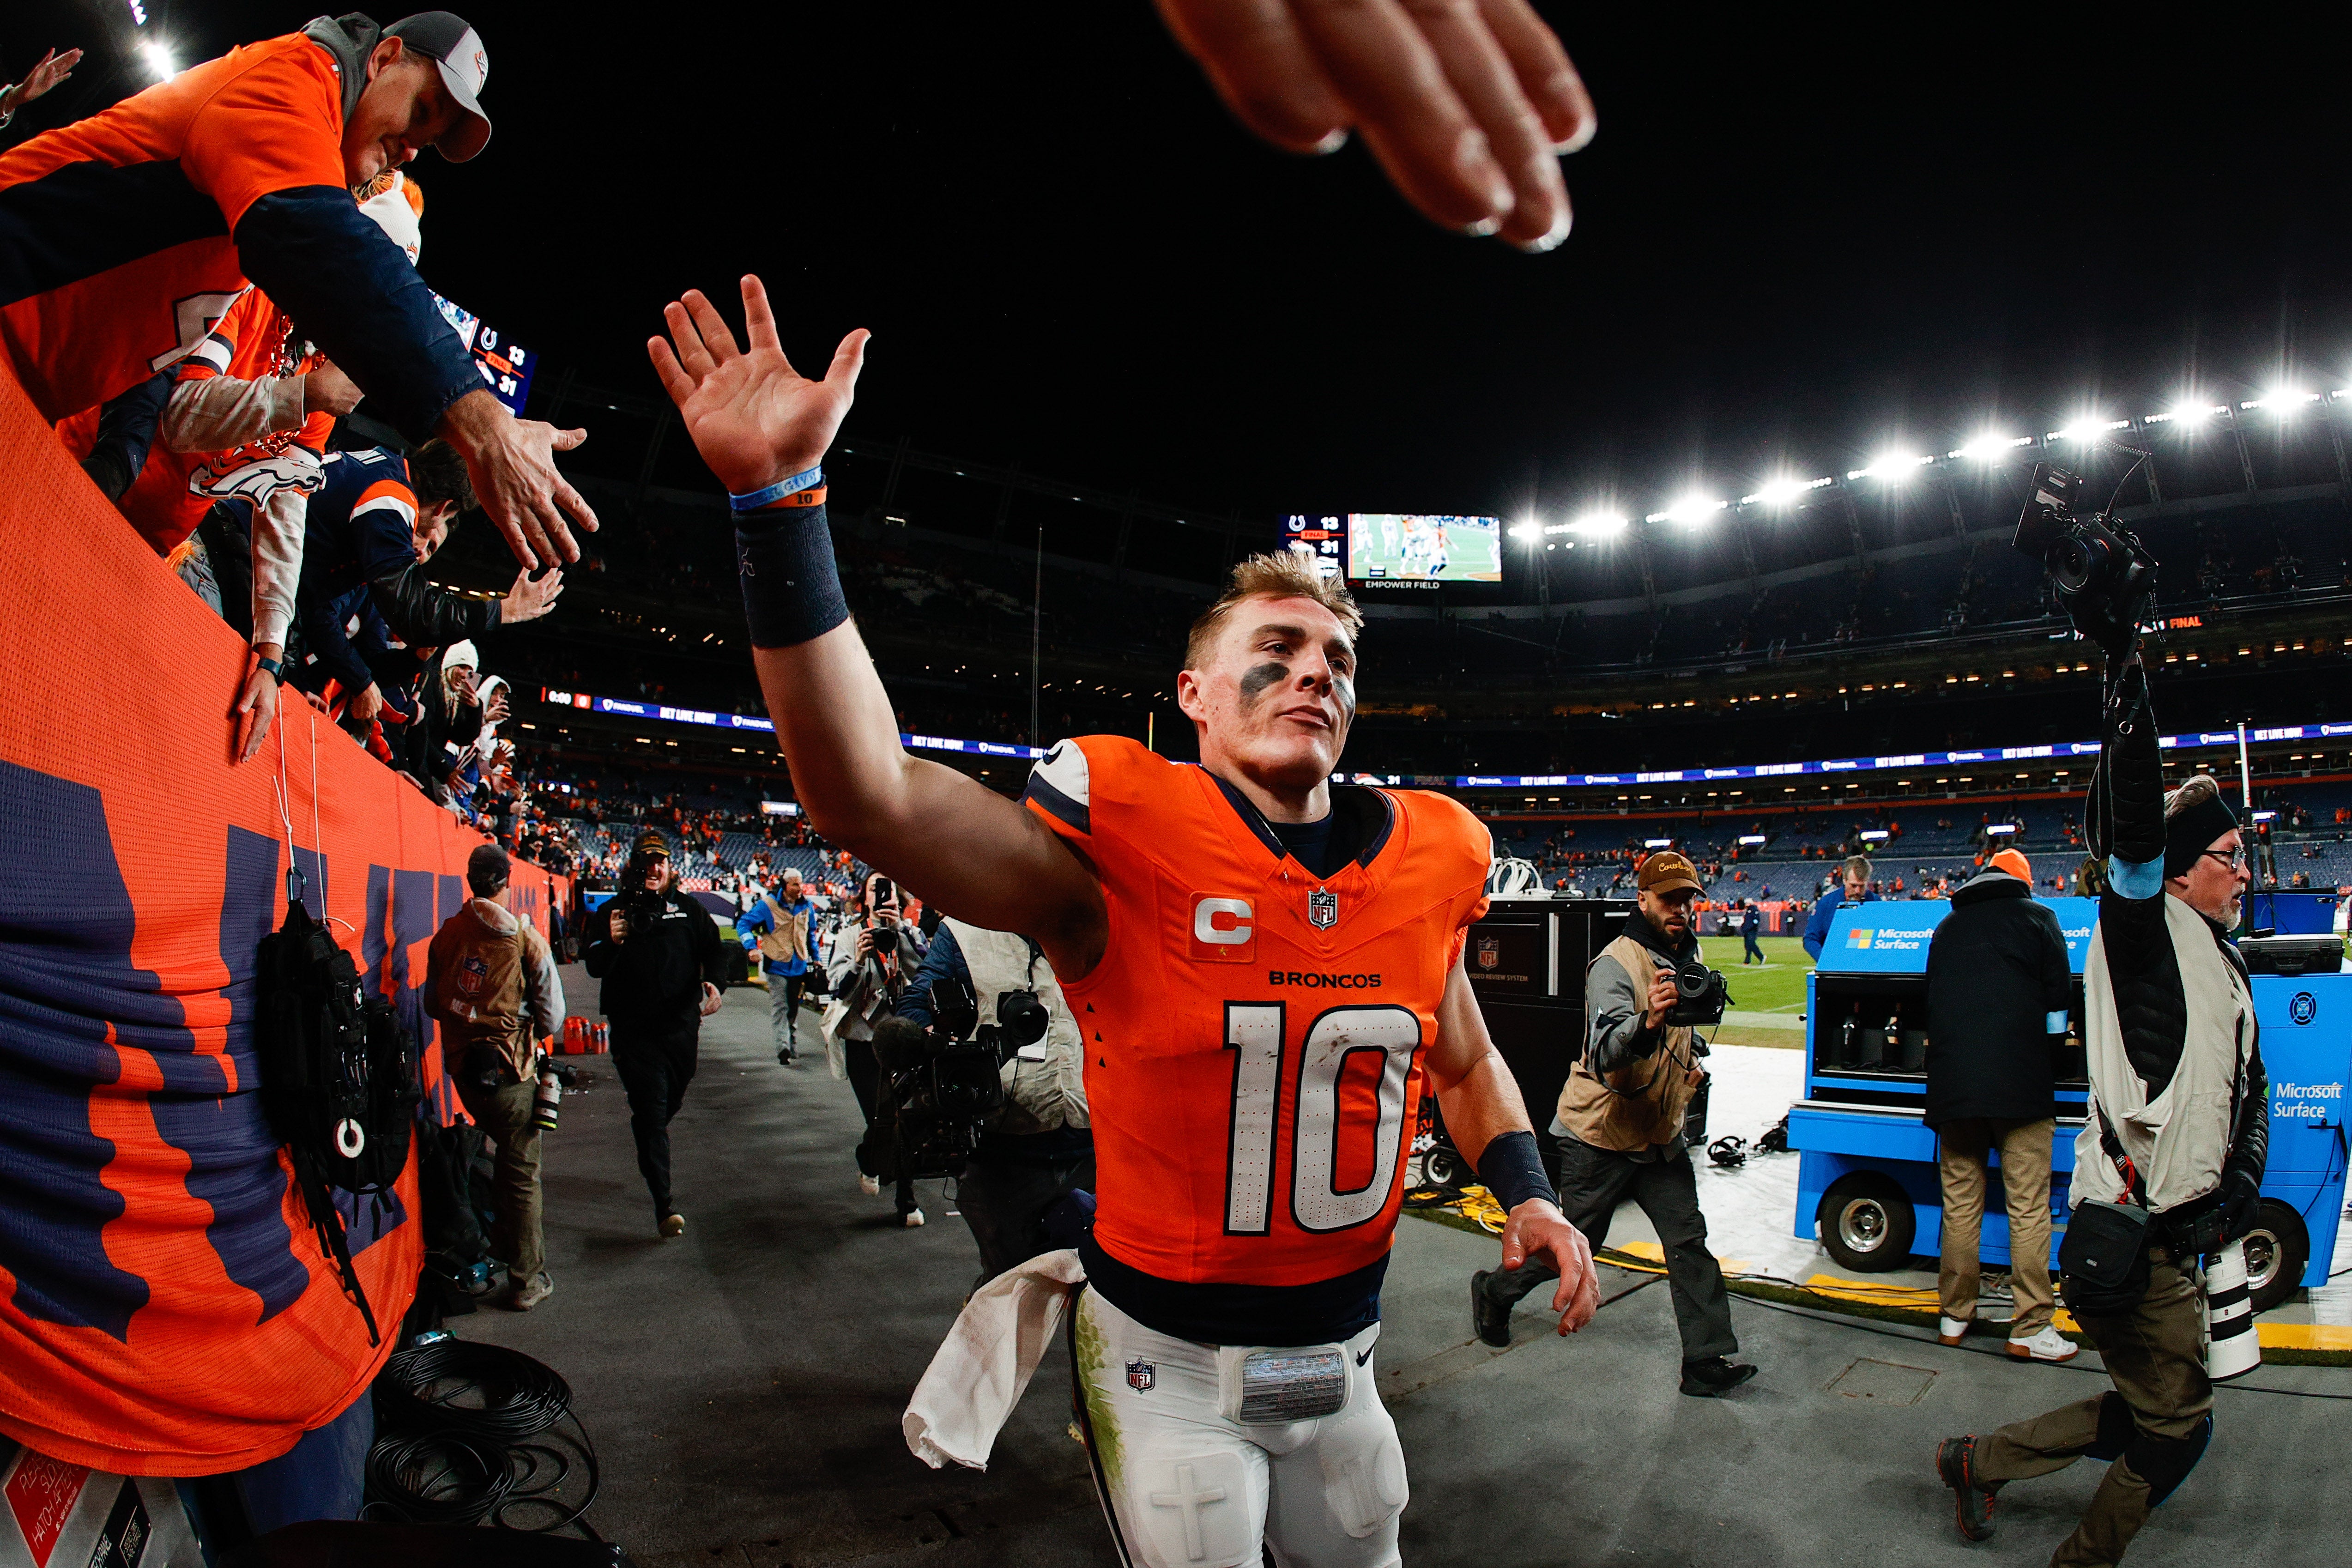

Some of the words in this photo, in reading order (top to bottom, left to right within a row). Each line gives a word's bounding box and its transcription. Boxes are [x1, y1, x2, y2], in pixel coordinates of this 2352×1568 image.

[508, 346, 525, 366] 13
[499, 375, 517, 397] 31
[797, 494, 813, 504] 10
[1320, 516, 1339, 530] 13
[1320, 540, 1339, 554] 31
[1365, 581, 1412, 589] EMPOWER
[2170, 616, 2202, 629] FINAL
[548, 690, 572, 705] 0:00
[613, 702, 645, 714] FANDUEL
[659, 707, 676, 720] BET
[676, 709, 694, 722] LIVE
[694, 711, 717, 725] NOW!
[742, 718, 774, 729] FANDUEL
[2329, 725, 2352, 734] FANDUE
[2209, 733, 2237, 742] FANDUEL
[2254, 729, 2268, 740] BET
[2268, 728, 2284, 739] LIVE
[2284, 727, 2304, 738] NOW!
[912, 735, 927, 747] BET
[927, 737, 944, 749] LIVE
[944, 739, 964, 751] NOW!
[987, 745, 1016, 754] FANDUEL
[1029, 747, 1044, 758] BET
[2002, 748, 2017, 759] BET
[2016, 747, 2033, 758] LIVE
[2032, 745, 2053, 757] NOW!
[1875, 757, 1889, 768] BET
[1888, 756, 1905, 767] LIVE
[1905, 754, 1925, 766] NOW!
[1755, 765, 1769, 776] BET
[1768, 764, 1784, 775] LIVE
[1784, 763, 1803, 774] NOW!
[1331, 773, 1345, 783] 13
[1387, 775, 1401, 785] 31
[1414, 775, 1447, 786] FINAL
[1520, 776, 1534, 786] BET
[1533, 776, 1549, 786] LIVE
[1548, 776, 1567, 785] NOW!
[1636, 773, 1650, 783] BET
[1649, 772, 1665, 782] LIVE
[1664, 771, 1683, 781] NOW!
[1313, 906, 1333, 923] NFL
[1194, 898, 1252, 945] C
[1877, 928, 1935, 939] Microsoft
[1874, 940, 1920, 950] Surface
[1480, 951, 1497, 966] NFL
[1269, 971, 1382, 988] BRONCOS
[2276, 1082, 2343, 1099] Microsoft
[2273, 1101, 2326, 1118] Surface
[1223, 1000, 1422, 1236] 10
[1130, 1374, 1150, 1388] NFL
